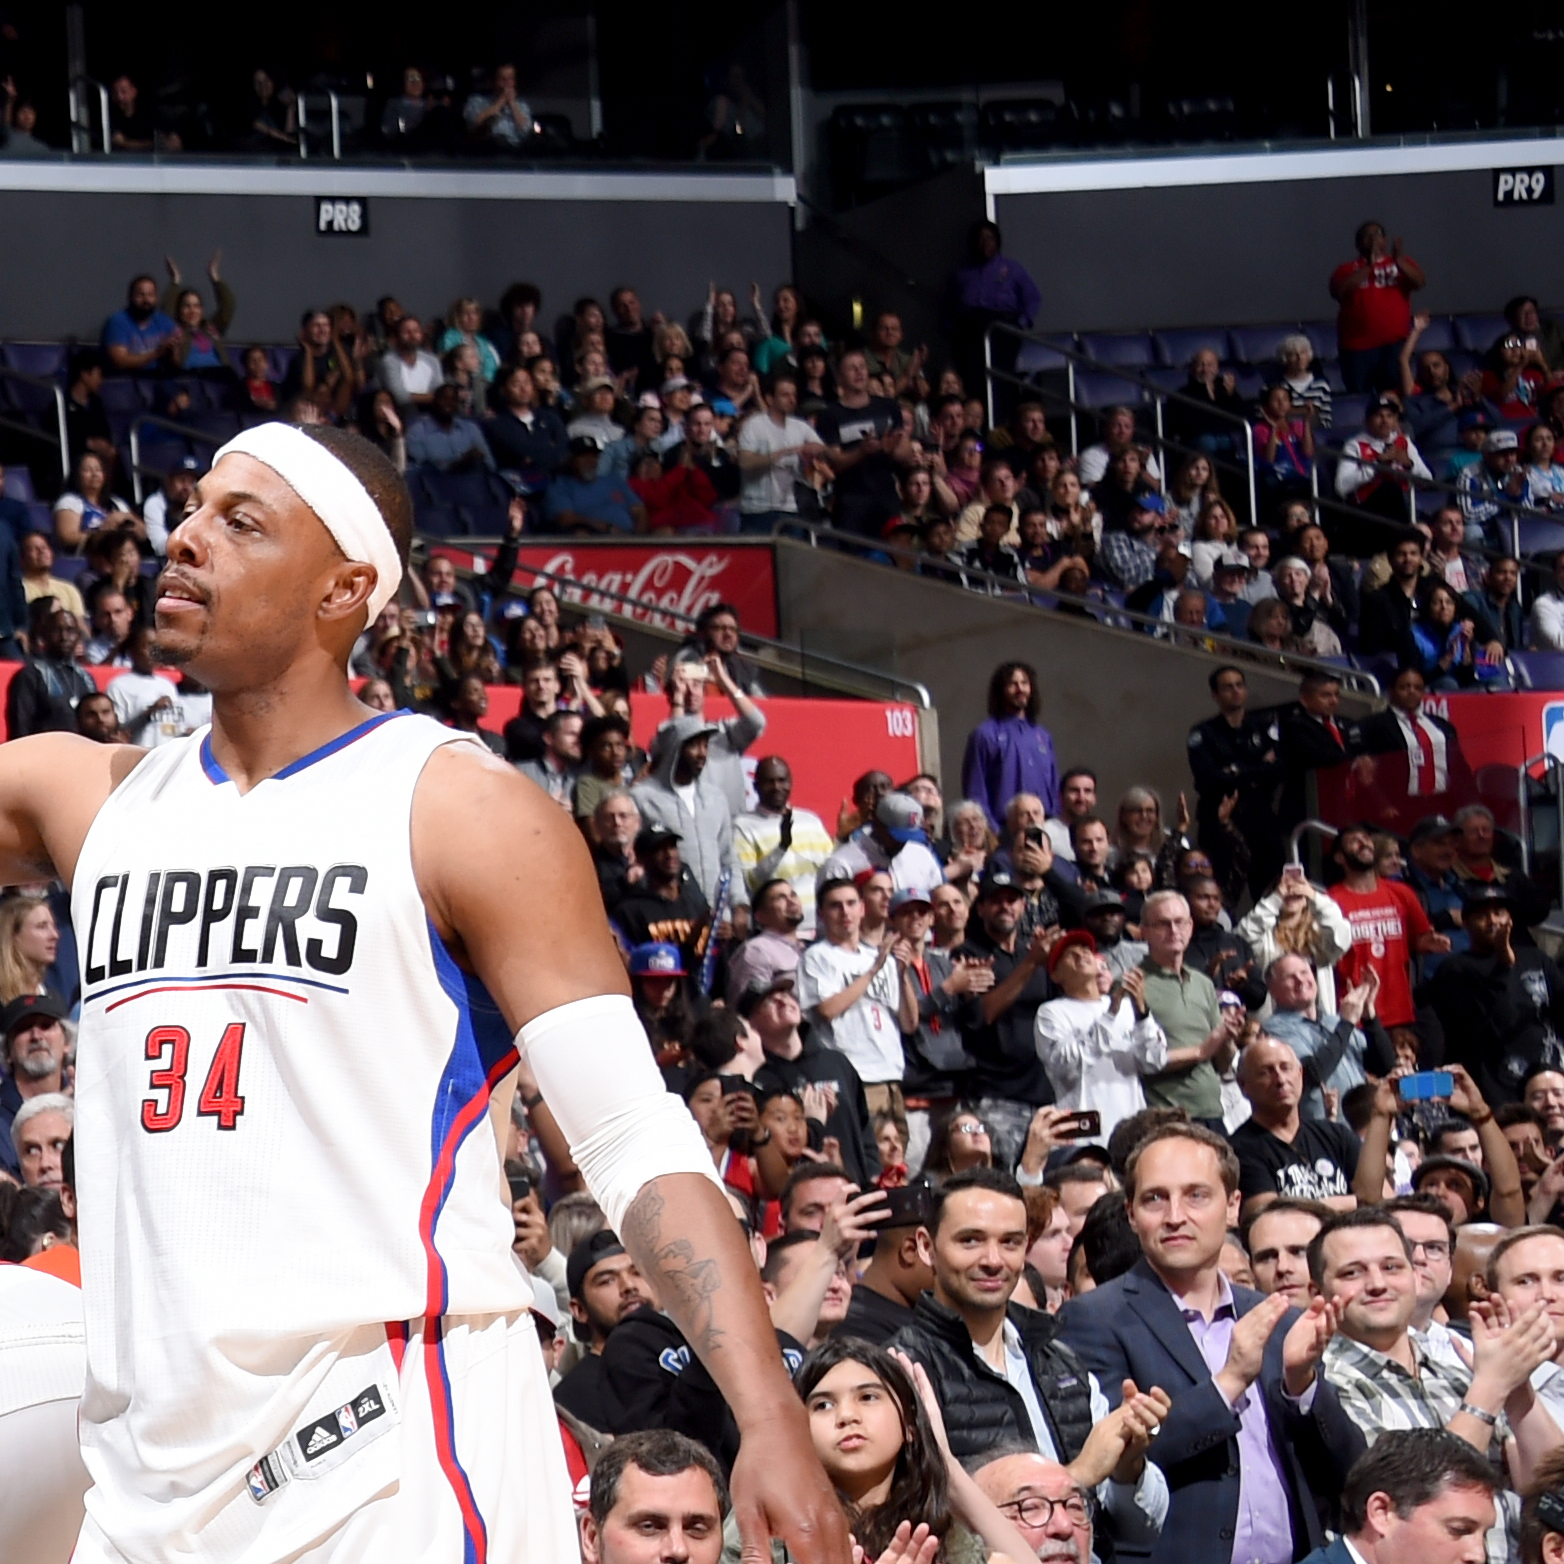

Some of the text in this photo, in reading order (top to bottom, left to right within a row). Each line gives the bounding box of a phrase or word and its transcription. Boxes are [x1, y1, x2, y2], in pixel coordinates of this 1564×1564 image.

[1497, 171, 1545, 202] PR9
[319, 201, 362, 232] PR8
[885, 706, 914, 738] 103
[85, 862, 368, 987] CLIPPERS
[141, 1022, 246, 1132] 34
